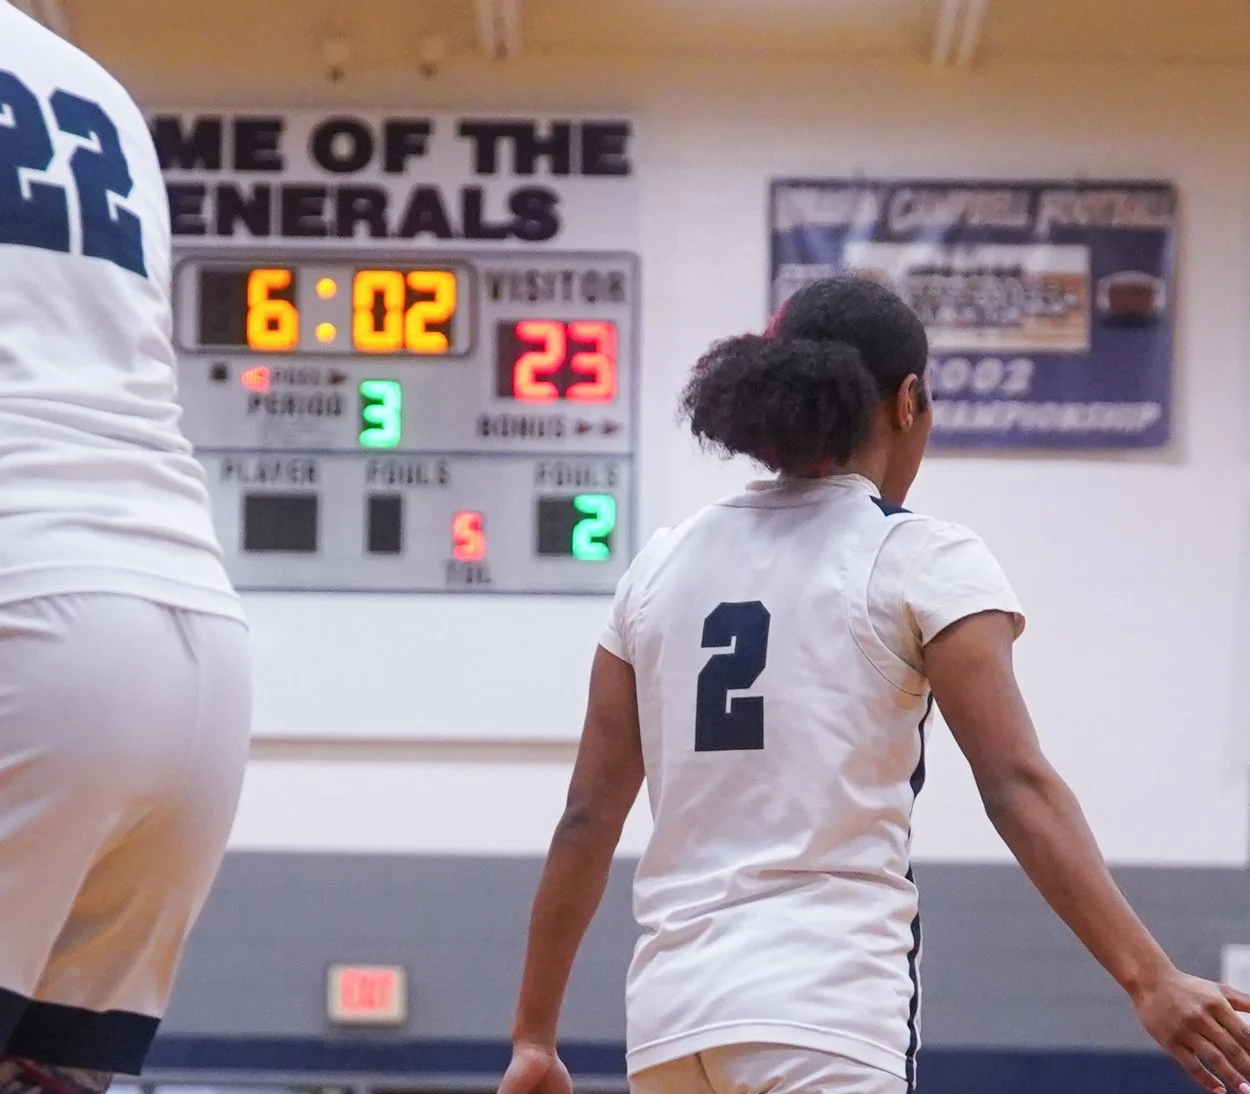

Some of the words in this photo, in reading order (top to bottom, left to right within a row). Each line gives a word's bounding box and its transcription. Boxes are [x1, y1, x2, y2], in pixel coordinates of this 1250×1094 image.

[0, 68, 148, 278] 22
[154, 114, 286, 171] ME
[312, 117, 431, 174] OF
[459, 119, 633, 176] THE
[166, 182, 561, 241] ENERALS
[246, 269, 456, 354] 6:02
[514, 320, 618, 404] 23
[930, 357, 1035, 395] 002
[358, 379, 402, 448] 3
[571, 493, 617, 562] 2
[695, 601, 770, 751] 2
